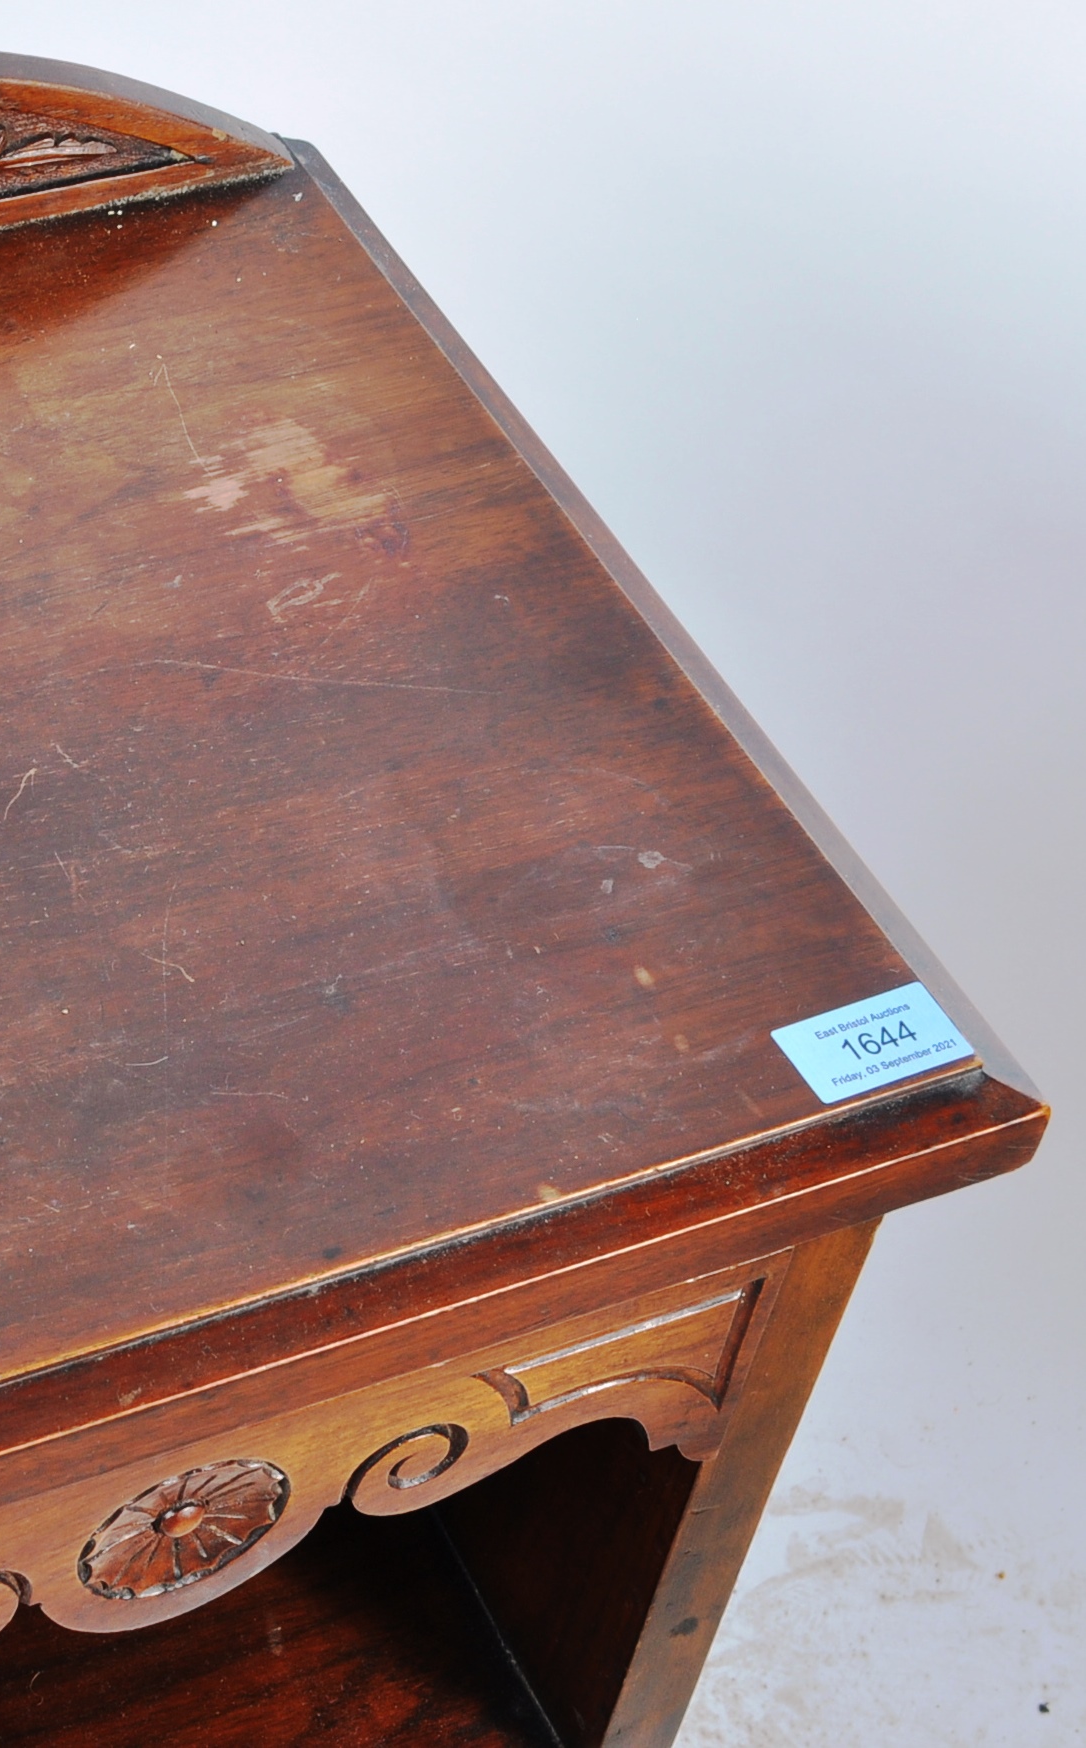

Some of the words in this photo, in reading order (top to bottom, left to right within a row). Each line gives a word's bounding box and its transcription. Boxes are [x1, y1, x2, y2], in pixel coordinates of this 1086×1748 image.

[815, 1027, 837, 1040] East
[838, 1016, 869, 1033] Bristol
[870, 1003, 910, 1022] Auctions
[842, 1020, 917, 1060] 1644
[831, 1069, 867, 1087] Friday,
[866, 1064, 880, 1075] 03
[881, 1047, 932, 1070] September
[932, 1038, 957, 1053] 2021
